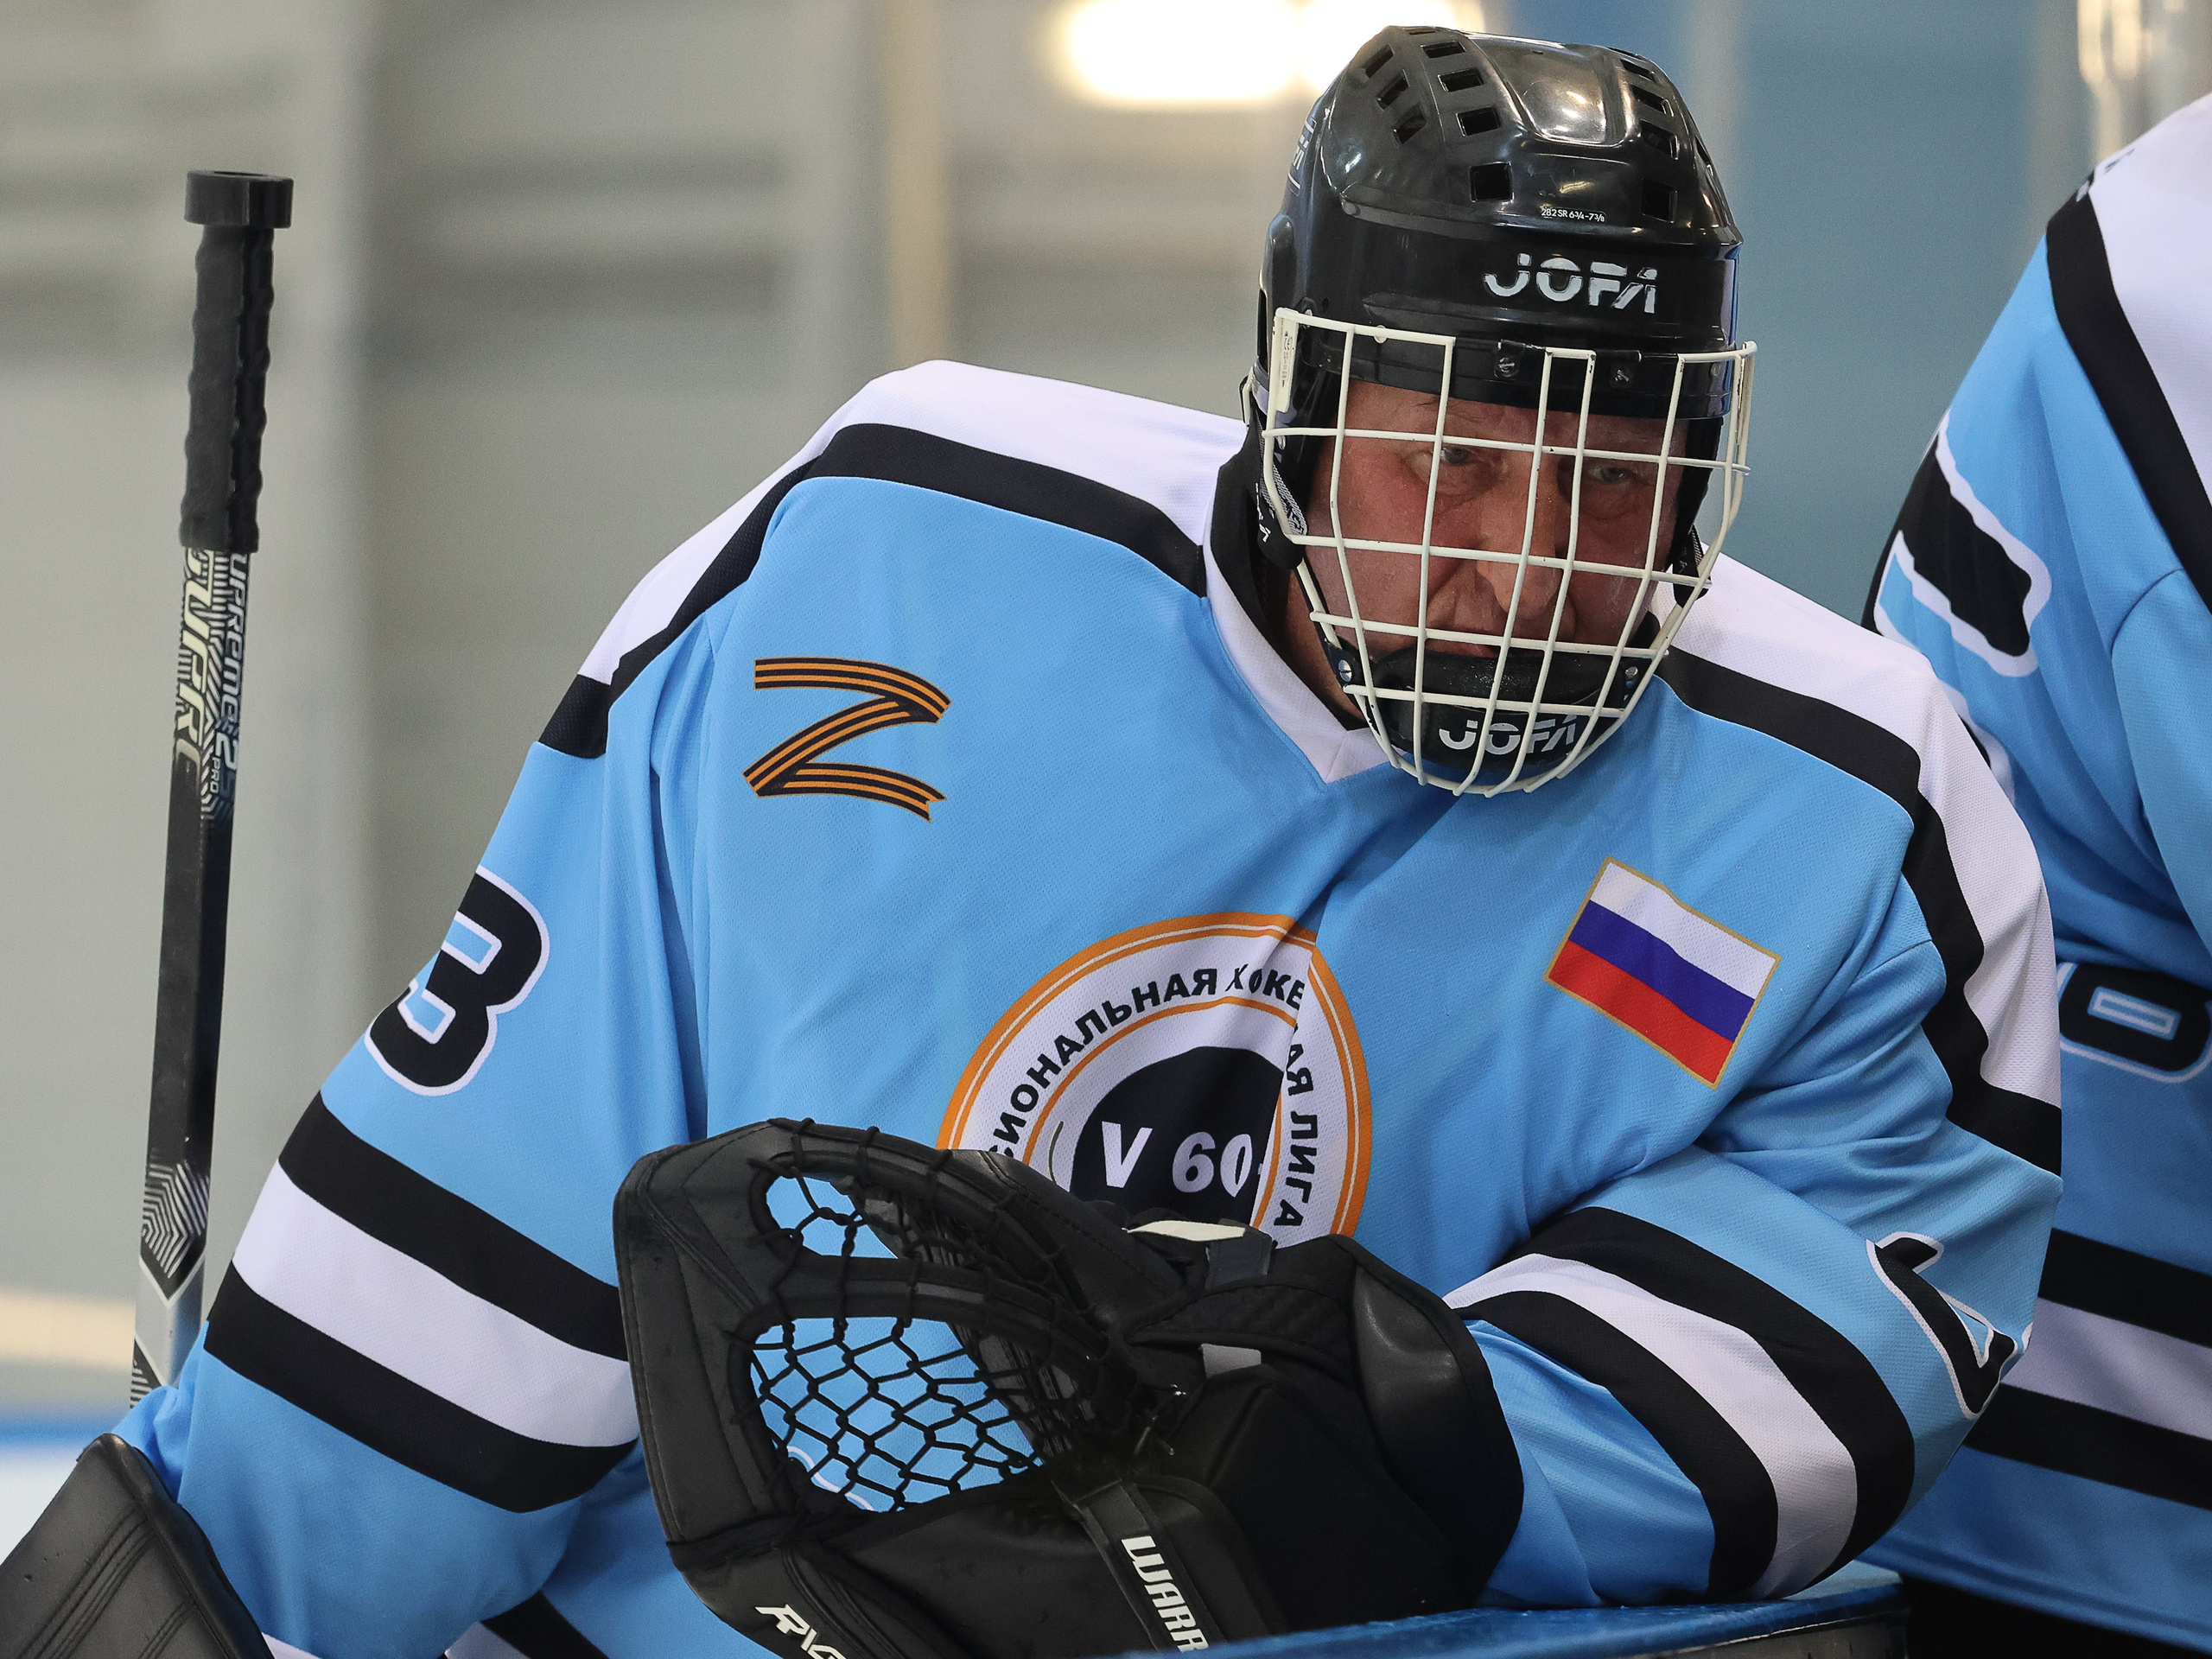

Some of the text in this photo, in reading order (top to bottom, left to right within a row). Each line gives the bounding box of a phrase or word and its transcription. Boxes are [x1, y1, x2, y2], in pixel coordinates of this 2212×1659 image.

[1541, 208, 1556, 217] 282
[1558, 209, 1567, 218] SR
[1484, 253, 1659, 313] JOFA
[743, 657, 951, 823] Z
[1439, 714, 1578, 755] JOFA
[1103, 1121, 1262, 1198] V 60
[1274, 1111, 1318, 1226] ЛИГА
